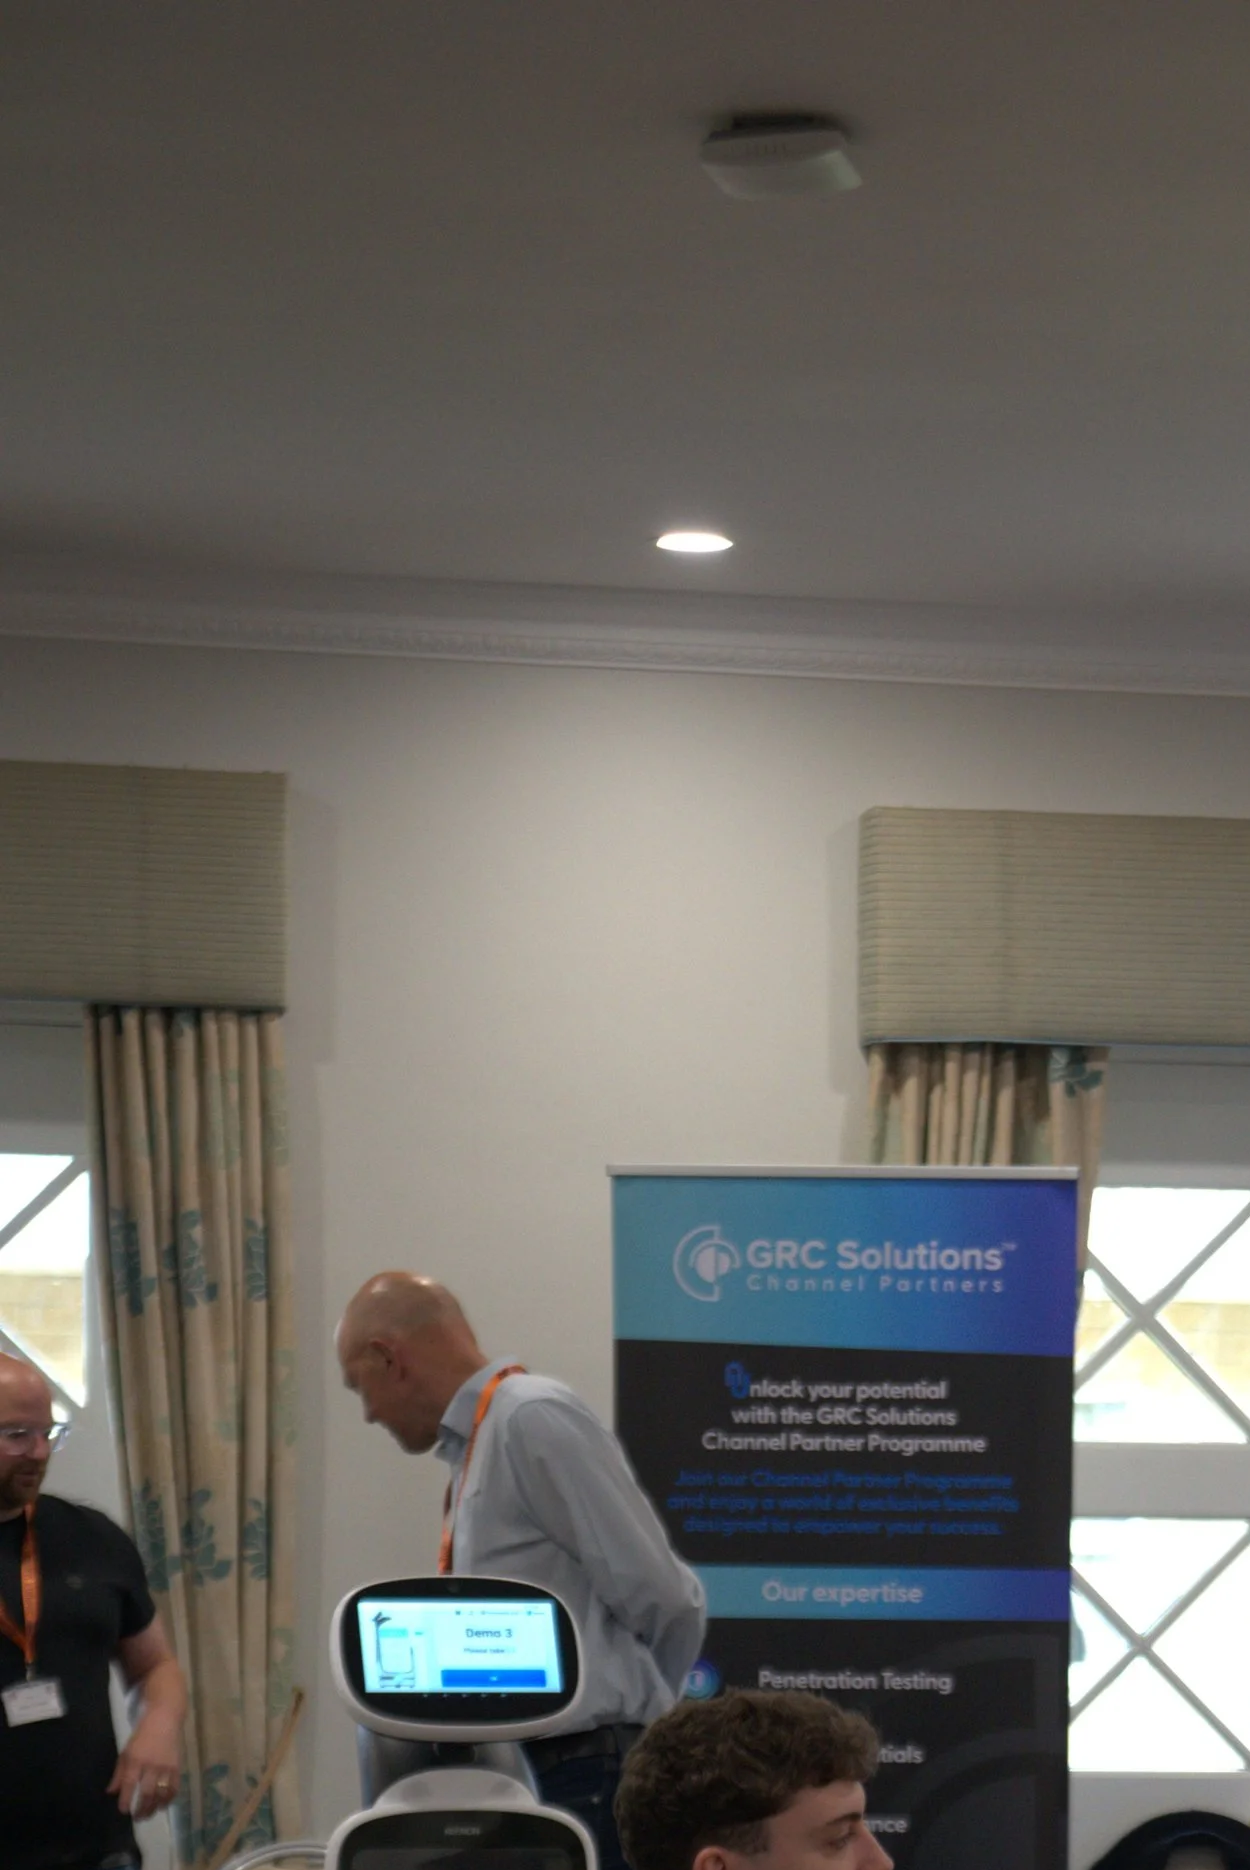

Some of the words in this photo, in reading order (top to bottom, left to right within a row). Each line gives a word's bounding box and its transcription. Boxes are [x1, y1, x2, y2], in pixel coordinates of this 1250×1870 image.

[746, 1240, 827, 1270] GRC
[747, 1274, 865, 1292] Channel
[880, 1276, 1004, 1294] Partners
[808, 1383, 853, 1402] your
[857, 1379, 949, 1402] potential
[731, 1406, 776, 1425] with
[780, 1406, 813, 1425] the
[816, 1408, 863, 1426] GRC
[866, 1408, 958, 1427] Solutions
[701, 1431, 787, 1452] Channel
[790, 1433, 864, 1453] Partner
[868, 1434, 987, 1456] Programme
[761, 1581, 808, 1602] Our
[812, 1583, 924, 1607] expertise
[466, 1628, 501, 1638] Demo
[505, 1628, 513, 1638] 3
[757, 1670, 878, 1690] Penetration
[881, 1671, 954, 1695] Testing
